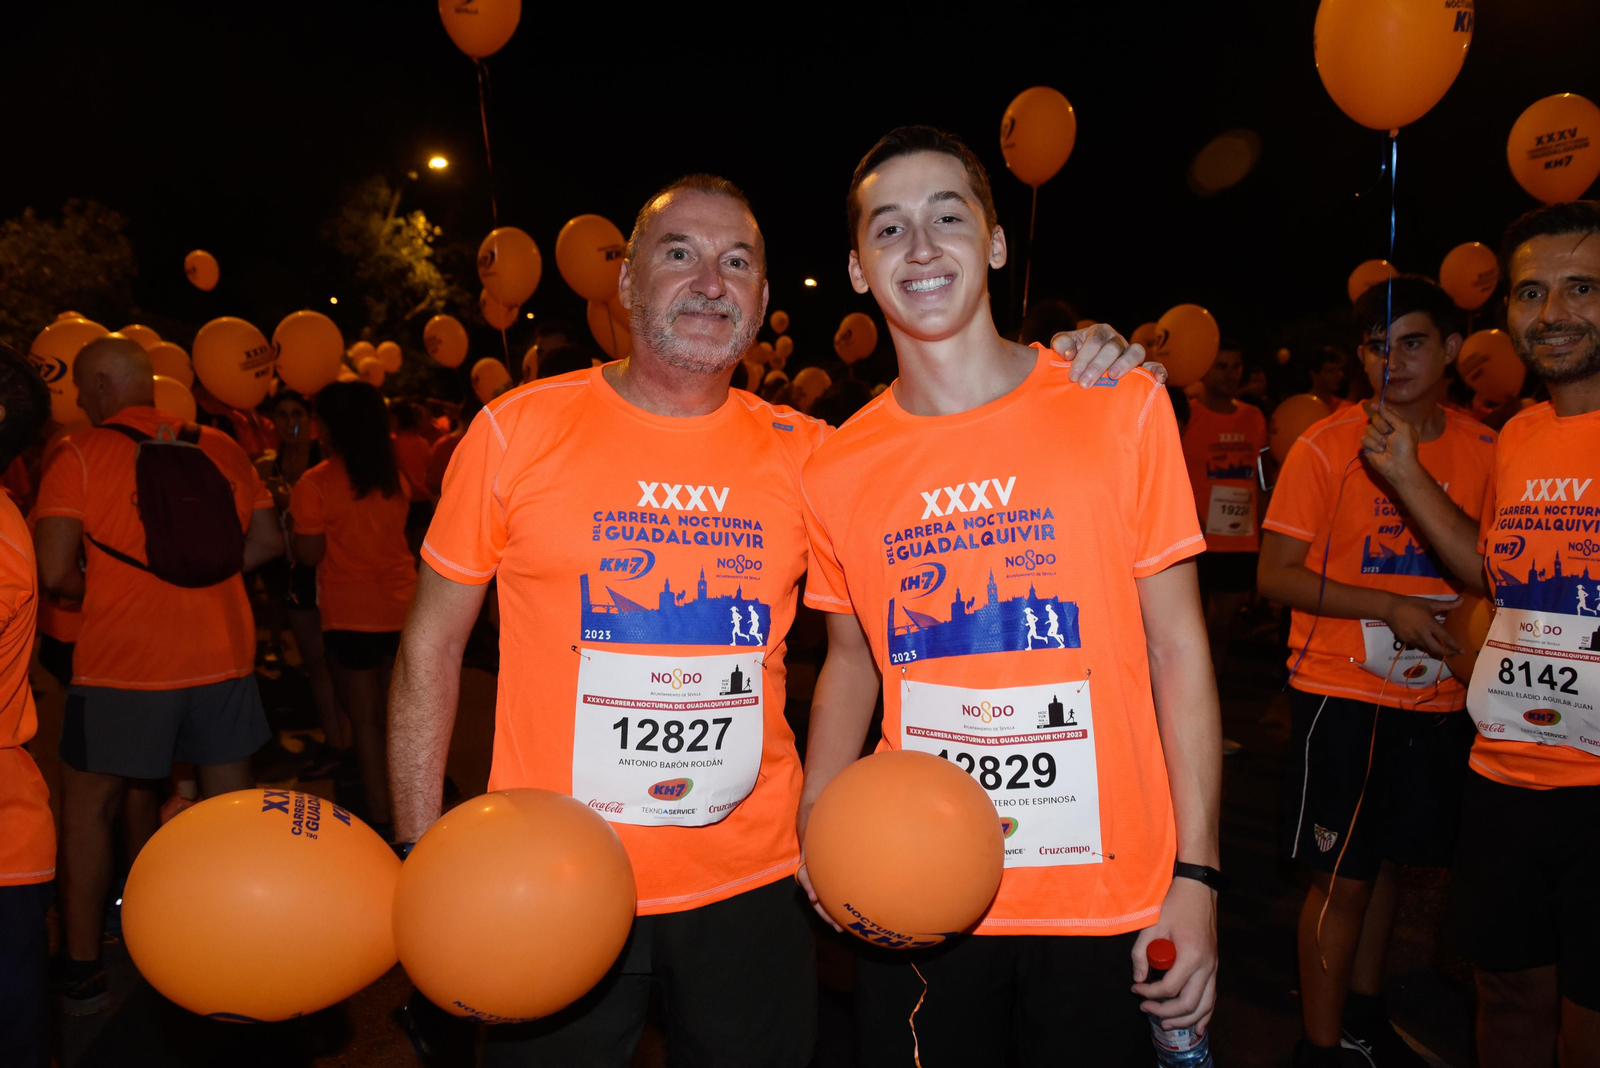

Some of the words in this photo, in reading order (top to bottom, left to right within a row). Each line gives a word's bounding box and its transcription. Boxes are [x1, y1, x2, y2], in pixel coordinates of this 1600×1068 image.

[1535, 127, 1577, 146] XXXV
[637, 480, 730, 512] XXXV
[920, 476, 1016, 520] XXXV
[1520, 478, 1593, 502] XXXV
[593, 510, 670, 526] CARRERA
[678, 514, 764, 532] NOCTURNA
[1500, 506, 1539, 516] CARRERA
[1544, 506, 1600, 517] NOCTURN
[592, 524, 601, 541] DEL
[604, 526, 764, 549] GUADALQUIVIR
[884, 520, 956, 545] CARRERA
[964, 508, 1055, 529] NOCTURNA
[1500, 518, 1600, 534] GUADALQUIVI
[886, 546, 896, 565] DEL
[896, 524, 1056, 560] GUADALQUIVIR
[584, 630, 612, 640] 2023
[892, 650, 917, 662] 2023
[1545, 650, 1590, 660] GUADALQUIVIR
[1498, 658, 1578, 696] 8142
[1488, 688, 1514, 697] MANUEL
[1516, 692, 1541, 701] ELADIO
[1543, 696, 1572, 706] AGUILAR
[1573, 702, 1593, 710] JUAN
[613, 717, 732, 753] 12827
[926, 730, 951, 739] CARRERA
[953, 734, 986, 744] NOCTURNA
[1000, 734, 1051, 744] GUADALQUIVIR
[619, 758, 657, 768] ANTONIO
[660, 759, 689, 768] BARÓN
[691, 758, 723, 768] ROLDÁN
[1032, 795, 1076, 805] ESPINOSA
[1039, 845, 1090, 855] Cruzcampo
[843, 903, 914, 942] NOCTURNA
